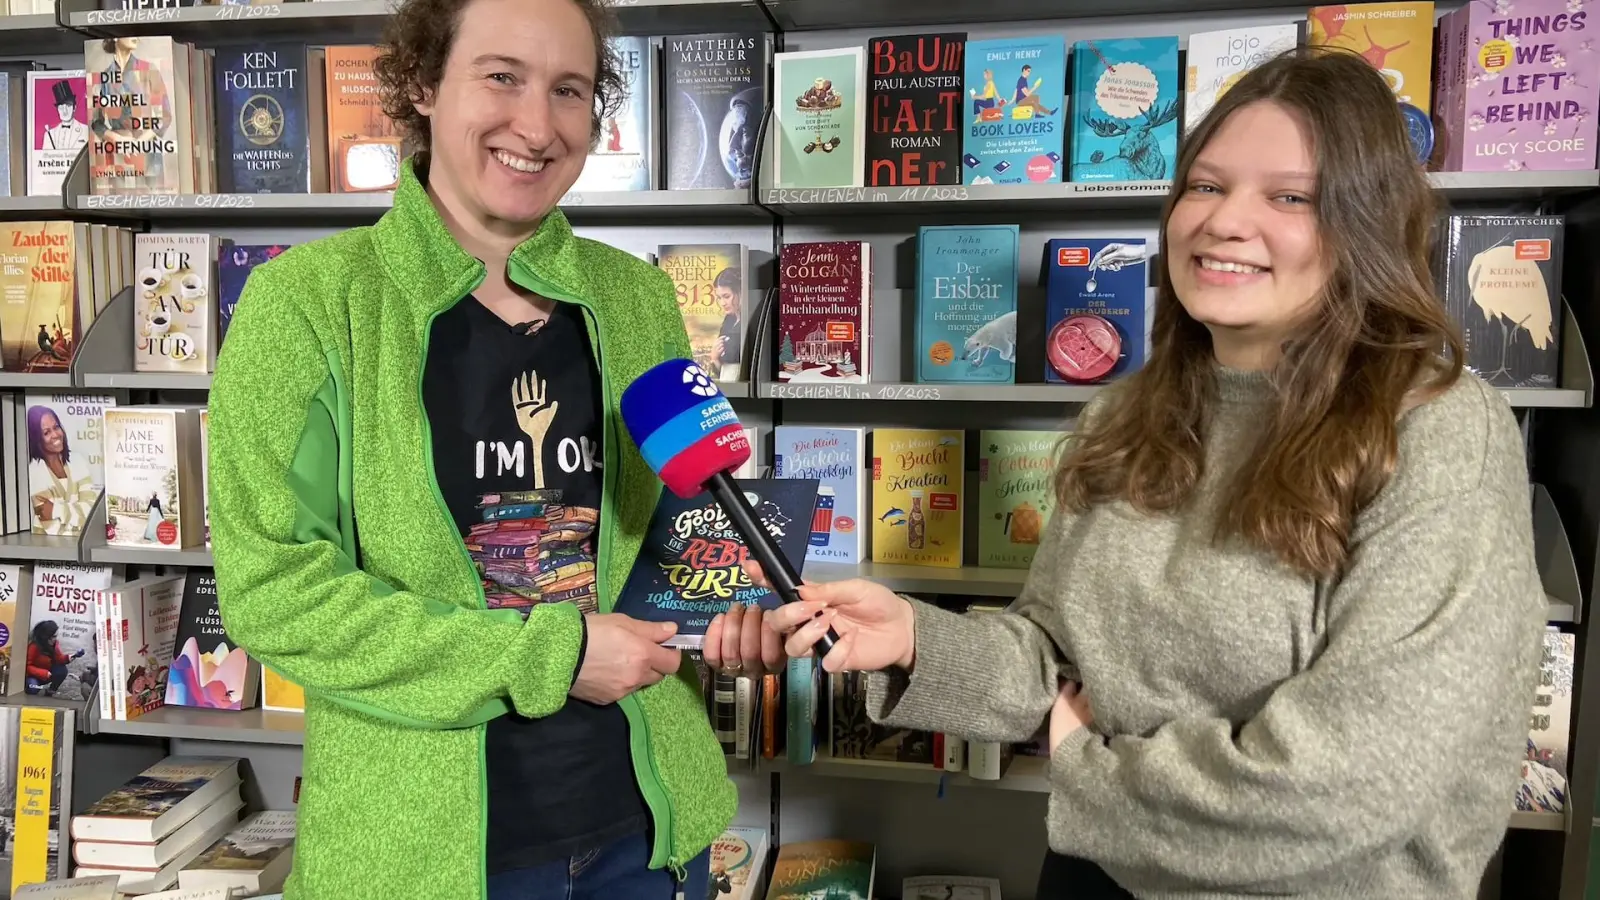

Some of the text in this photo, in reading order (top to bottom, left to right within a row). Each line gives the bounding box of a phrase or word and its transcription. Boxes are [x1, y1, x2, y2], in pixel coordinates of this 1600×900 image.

[216, 4, 281, 20] 11/2023
[1332, 9, 1417, 22] JASMIN SCHREIBER
[1487, 11, 1588, 39] THINGS
[672, 38, 755, 53] MATTHIAS
[1228, 34, 1260, 56] jojo
[242, 51, 278, 70] KEN
[681, 49, 747, 63] MAURER
[987, 49, 1041, 62] EMILY HENRY
[1515, 44, 1556, 65] WE
[335, 59, 368, 68] JOCHEN
[100, 71, 122, 85] DIE
[334, 72, 346, 81] ZU
[676, 67, 751, 78] COSMIC KISS
[224, 69, 298, 91] FOLLETT
[874, 75, 961, 91] PAUL AUSTER
[1104, 76, 1155, 89] Jonas Jonasson
[1501, 71, 1567, 95] LEFT
[92, 94, 148, 108] FORMEL
[339, 98, 369, 106] Schmidt
[1485, 99, 1580, 124] BEHIND
[131, 117, 160, 130] DER
[971, 121, 1054, 137] BOOK LOVERS
[94, 140, 175, 155] HOFFNUNG
[890, 136, 941, 149] ROMAN
[998, 139, 1017, 147] Liebe
[1475, 138, 1585, 157] LUCY SCORE
[233, 149, 294, 161] DIE WAFFEN DES
[38, 159, 65, 168] Arsène
[247, 160, 281, 171] LICHTS
[95, 169, 145, 179] LYNN CULLEN
[767, 187, 866, 204] ERSCHIENEN
[898, 186, 969, 201] 11/2023
[1486, 218, 1563, 227] POLLATSCHEK
[12, 229, 68, 247] Zauber
[137, 236, 206, 245] DOMINIK BARTA
[956, 235, 981, 245] John
[42, 248, 69, 264] der
[149, 247, 191, 270] TÜR
[799, 248, 839, 267] Jenny
[936, 246, 1000, 257] Ironmonger
[0, 254, 28, 265] lorian
[665, 255, 717, 268] SABINE
[4, 264, 25, 276] Illies
[31, 265, 72, 283] Stille
[666, 267, 717, 281] EBERT
[786, 263, 854, 279] COLGAN
[956, 261, 982, 274] Der
[1490, 267, 1529, 276] KLEINE
[790, 283, 849, 294] Winterträume
[931, 275, 1003, 300] Eisbär
[1480, 280, 1538, 289] PROBLEME
[793, 294, 845, 303] in der kleinen
[1088, 300, 1106, 308] DER
[782, 303, 858, 317] Buchhandlung
[948, 301, 985, 311] und die
[1064, 308, 1131, 316] TEEZAUBERER
[934, 311, 981, 324] Hoffnung
[149, 334, 188, 356] TÜR
[51, 392, 110, 404] MICHELLE
[770, 383, 941, 400] ERSCHIENEN 10/2023
[66, 405, 102, 416] OBAM
[124, 428, 154, 442] JANE
[116, 441, 164, 454] AUSTEN
[792, 437, 840, 453] Die kleine
[475, 439, 525, 479] I'M
[782, 448, 853, 472] Bäckerei
[895, 448, 950, 471] Bucht
[797, 463, 855, 480] Brooklyn
[886, 472, 950, 492] Kroatien
[814, 549, 849, 557] CAPLIN
[882, 551, 950, 563] JULIE CAPLIN
[42, 573, 75, 585] NACH
[645, 589, 674, 603] 100
[49, 599, 87, 614] LAND
[201, 626, 226, 635] LAND
[23, 766, 46, 780] 1964
